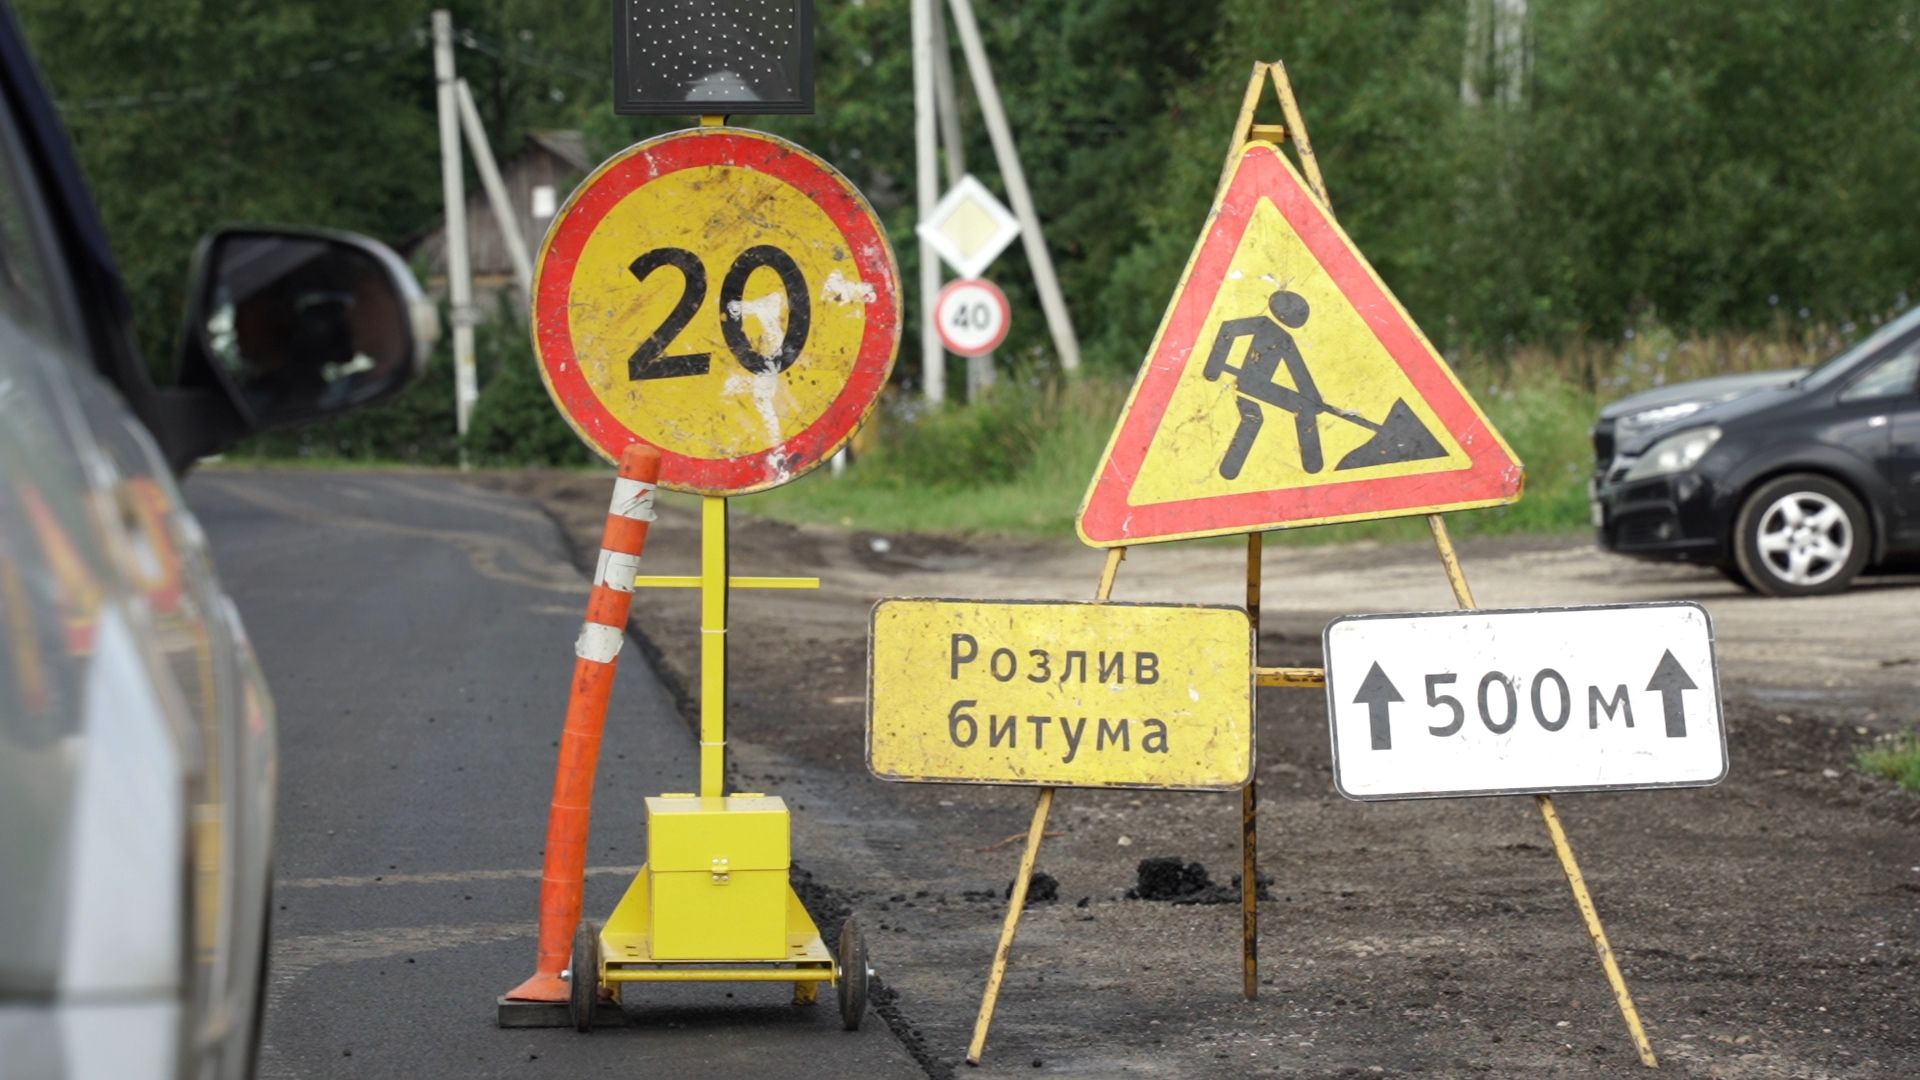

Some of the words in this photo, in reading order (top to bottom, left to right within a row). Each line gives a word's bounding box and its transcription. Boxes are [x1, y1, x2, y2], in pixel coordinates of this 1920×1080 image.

[628, 244, 811, 381] 20
[952, 302, 991, 331] 40
[950, 633, 1160, 685] Розлив
[948, 699, 1170, 764] битума
